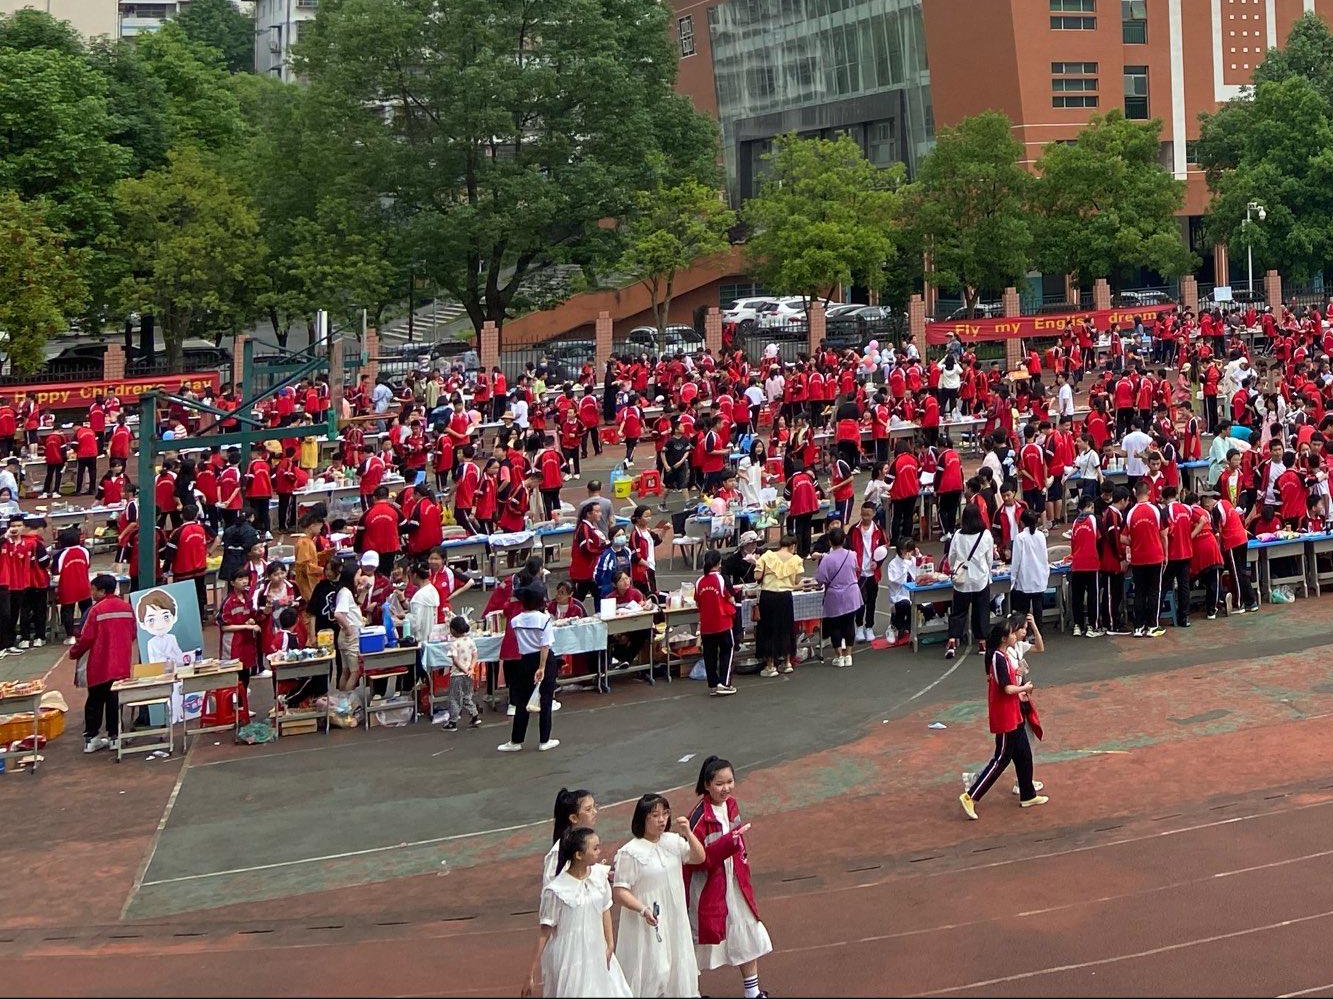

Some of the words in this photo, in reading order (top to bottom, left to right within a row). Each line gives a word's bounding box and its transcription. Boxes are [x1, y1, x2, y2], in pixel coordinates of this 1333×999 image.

[955, 324, 981, 337] Fly
[995, 322, 1021, 334] my
[1035, 315, 1089, 330] Englis
[1108, 312, 1157, 323] drem
[15, 391, 70, 404] Hppy
